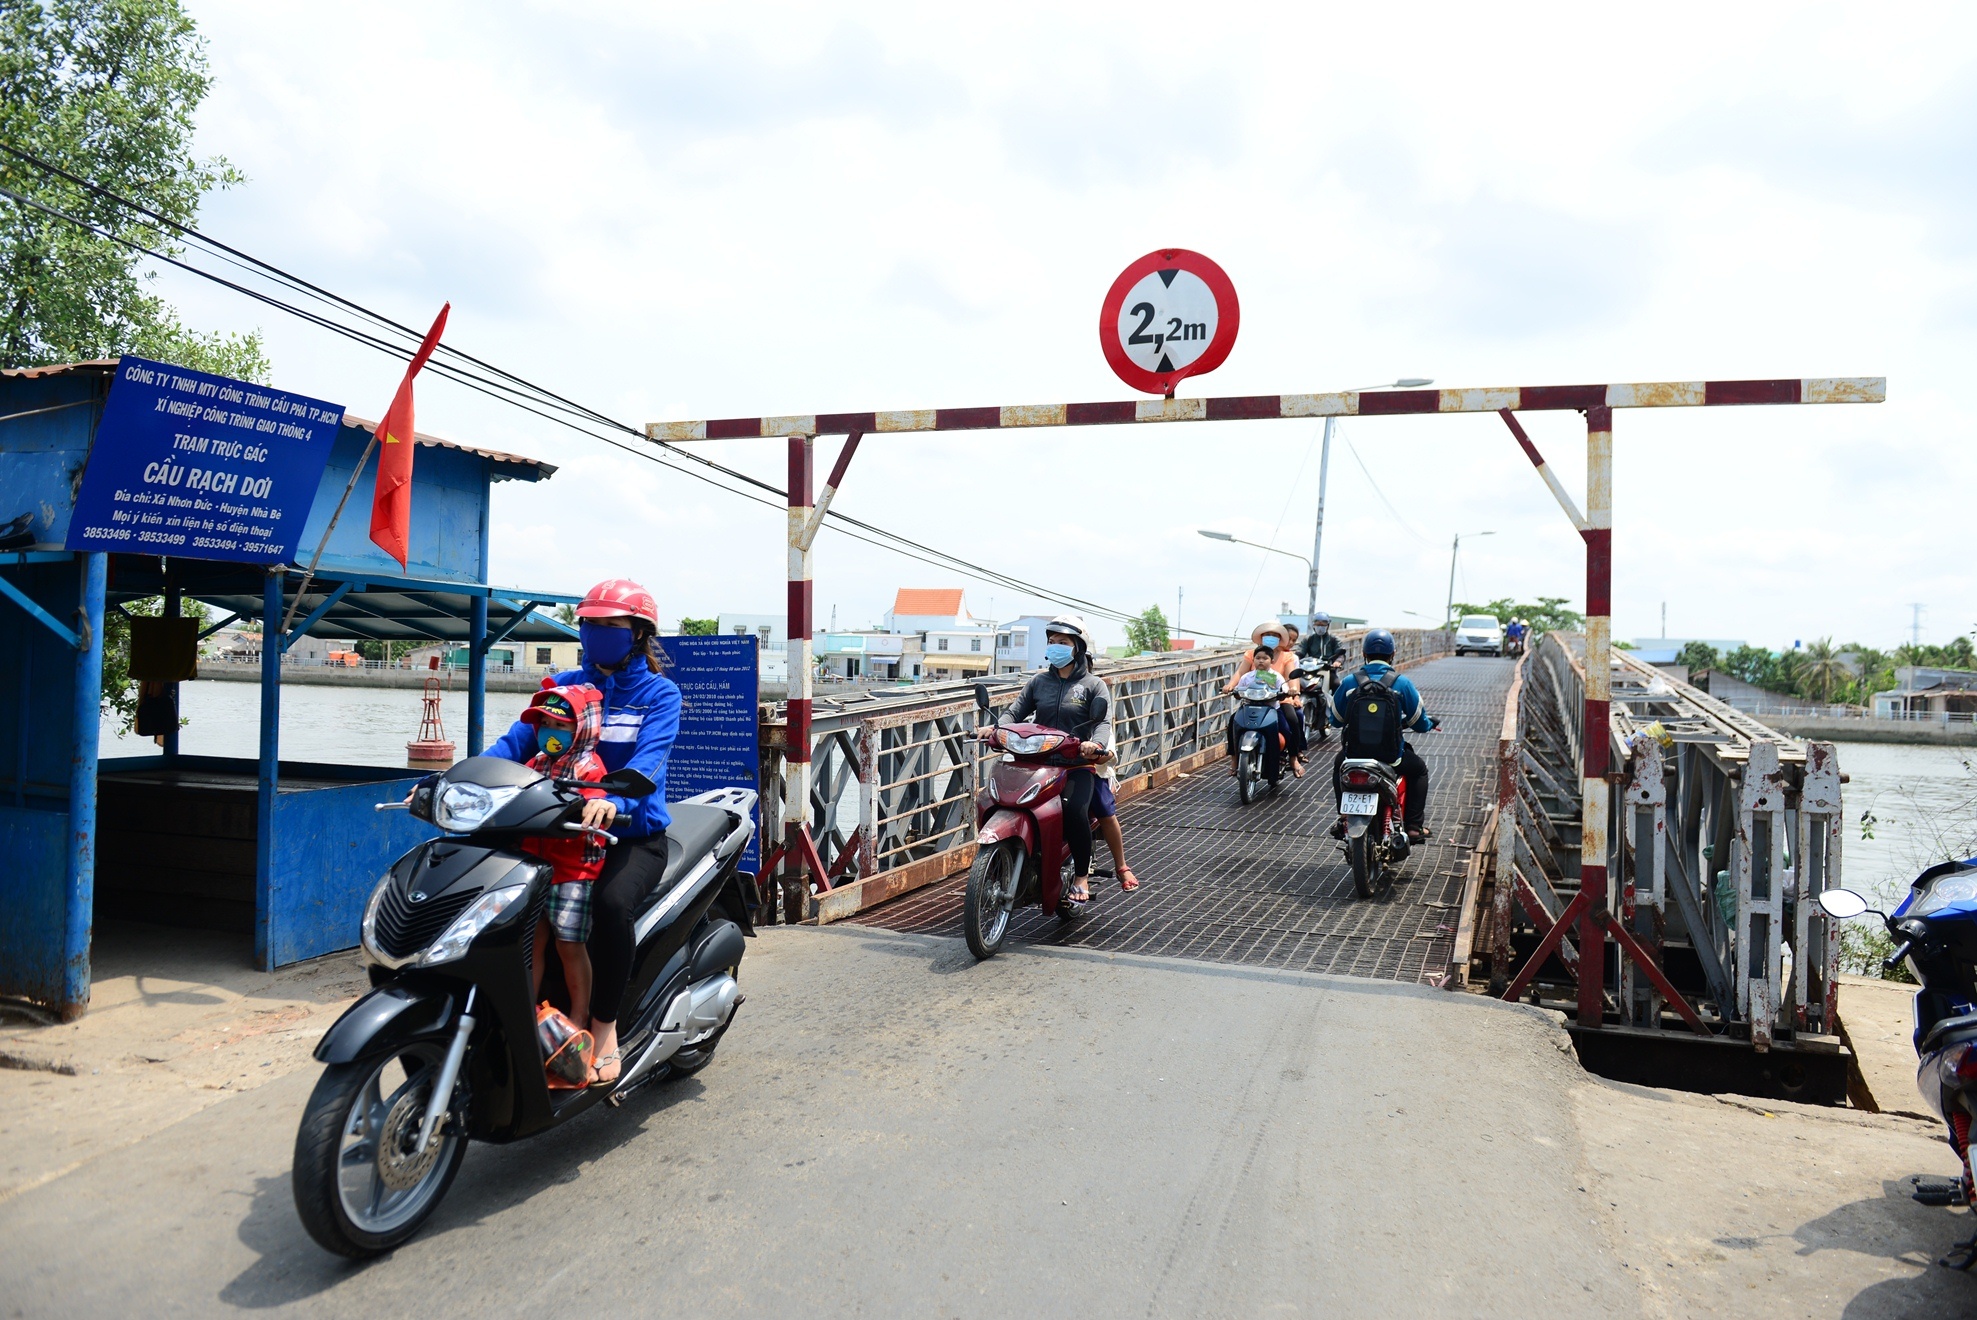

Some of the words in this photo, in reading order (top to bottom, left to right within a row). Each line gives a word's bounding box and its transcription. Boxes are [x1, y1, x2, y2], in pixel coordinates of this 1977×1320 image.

[1128, 302, 1206, 354] 2,2m
[125, 364, 154, 385] CÔNG
[156, 372, 170, 387] TY
[171, 375, 198, 393] TNHH
[197, 382, 219, 398] MTV
[218, 385, 243, 404] CÔNG
[244, 391, 271, 409] TRÌNH
[271, 395, 290, 414] CẦU
[289, 402, 308, 418] PHÀ
[308, 407, 339, 426] TP.HCM
[154, 395, 170, 412] XÍ
[166, 400, 203, 421] NGHIỆP
[203, 405, 228, 424] CÔNG
[228, 411, 256, 430] TRÌNH
[256, 419, 277, 434] GIAO
[277, 422, 306, 440] THÔNG
[305, 430, 313, 441] 4
[173, 433, 210, 455] TRẠM
[210, 439, 243, 461] TRỰC
[243, 442, 268, 463] GÁC
[143, 454, 185, 487] CẦU
[185, 468, 239, 495] RẠCH
[239, 476, 273, 499] DƠI
[151, 493, 167, 505] Xã
[167, 495, 192, 508] Nhơn
[194, 498, 213, 511] Đức
[219, 502, 249, 517] Huyện
[250, 506, 268, 518] Nhà
[269, 508, 282, 520] Bè
[112, 510, 133, 525] Mọi
[132, 510, 141, 524] ý
[141, 511, 163, 524] kiến
[165, 515, 181, 526] xin
[201, 519, 214, 533] hệ
[216, 519, 231, 531] số
[229, 522, 249, 536] điện
[250, 525, 274, 540] thoại
[83, 526, 132, 540] 38533496
[138, 531, 186, 545] 38533499
[192, 536, 237, 550] 38533494
[242, 542, 284, 555] 39571647
[1342, 804, 1375, 814] 024.17
[1348, 794, 1372, 803] 62-E1
